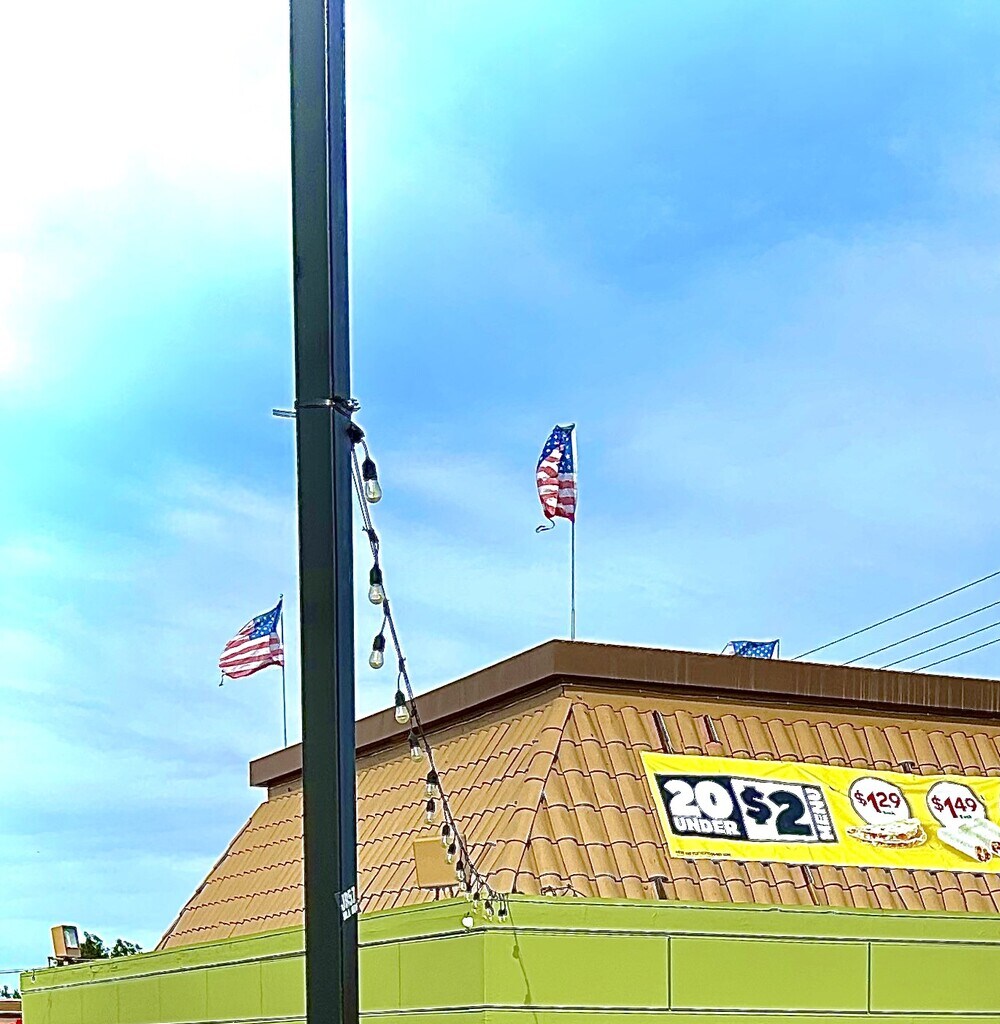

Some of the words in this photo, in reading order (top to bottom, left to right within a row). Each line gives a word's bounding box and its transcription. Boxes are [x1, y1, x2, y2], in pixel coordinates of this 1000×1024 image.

[663, 779, 734, 820] 20
[740, 785, 813, 836] $2
[805, 787, 834, 840] MENU
[672, 816, 741, 836] UNDER
